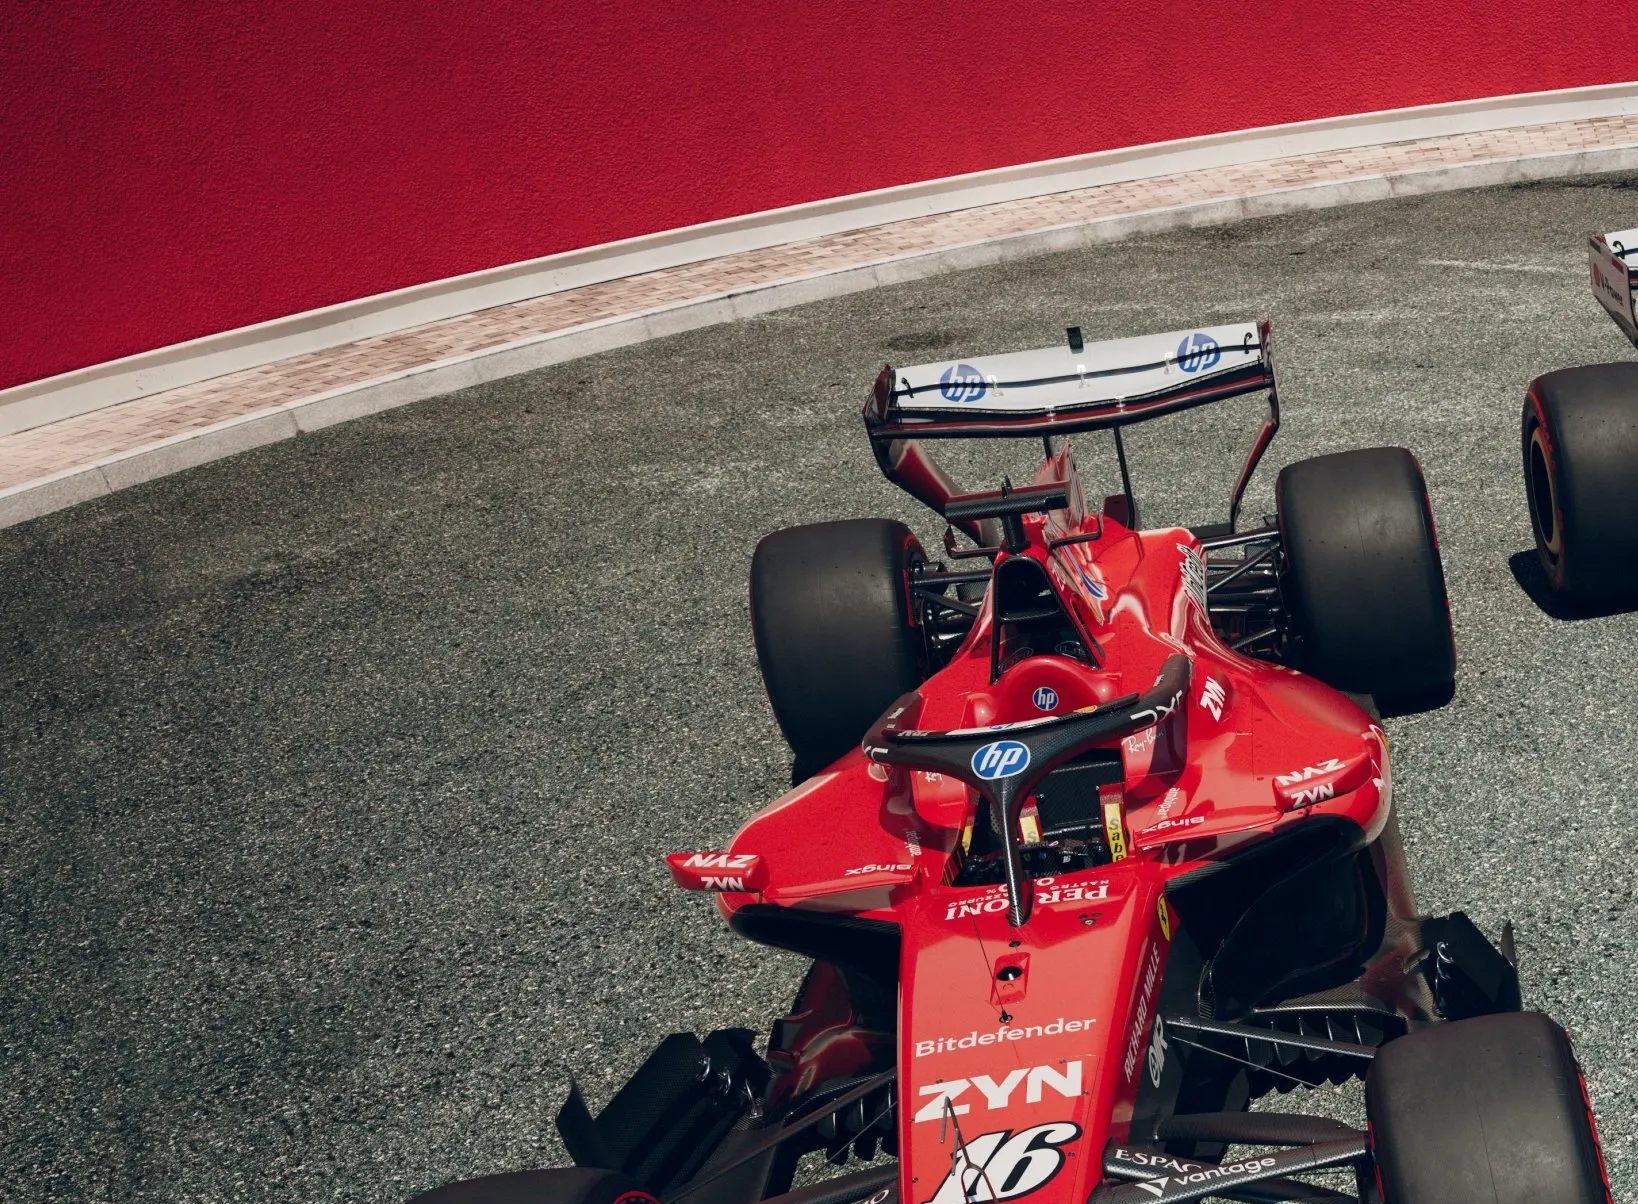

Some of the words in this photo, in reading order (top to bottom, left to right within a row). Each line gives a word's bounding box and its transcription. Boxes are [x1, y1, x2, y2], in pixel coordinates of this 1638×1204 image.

[1036, 687, 1056, 710] hp
[1200, 676, 1225, 722] ZYN
[981, 741, 1020, 780] hp
[1290, 783, 1335, 810] ZYN
[701, 876, 745, 891] ZYN
[1124, 995, 1148, 1084] RICHARD
[1143, 942, 1160, 1002] MILLE
[915, 1018, 1096, 1057] Bitdefender
[914, 1060, 1083, 1124] ZYN
[1174, 1157, 1276, 1186] vantage
